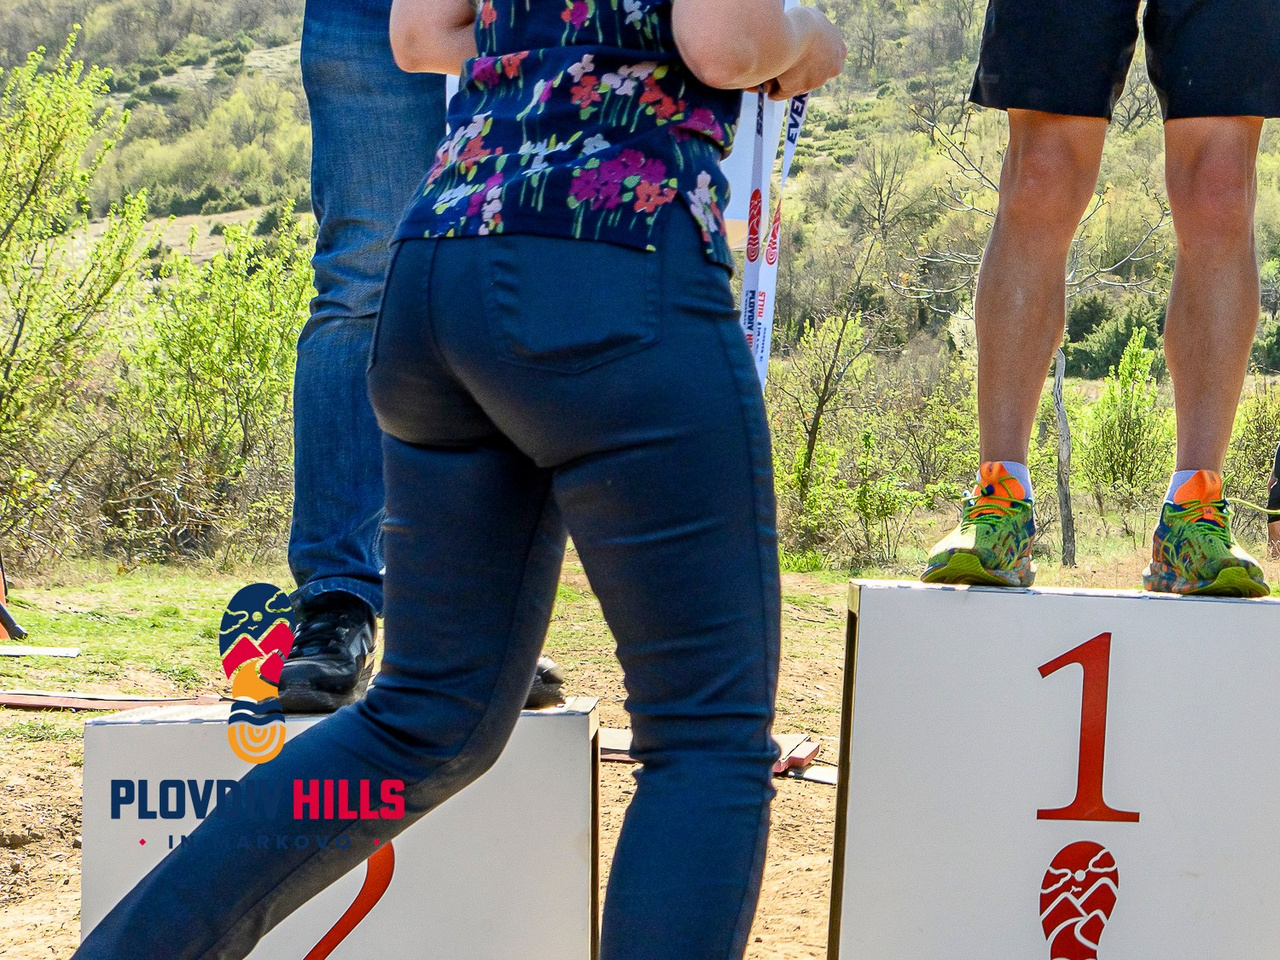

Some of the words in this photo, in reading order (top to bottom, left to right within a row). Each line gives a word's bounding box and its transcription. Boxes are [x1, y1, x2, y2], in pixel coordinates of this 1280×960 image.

[747, 290, 756, 331] PLOVDIV
[757, 291, 766, 318] HILLS
[1036, 631, 1140, 823] 1
